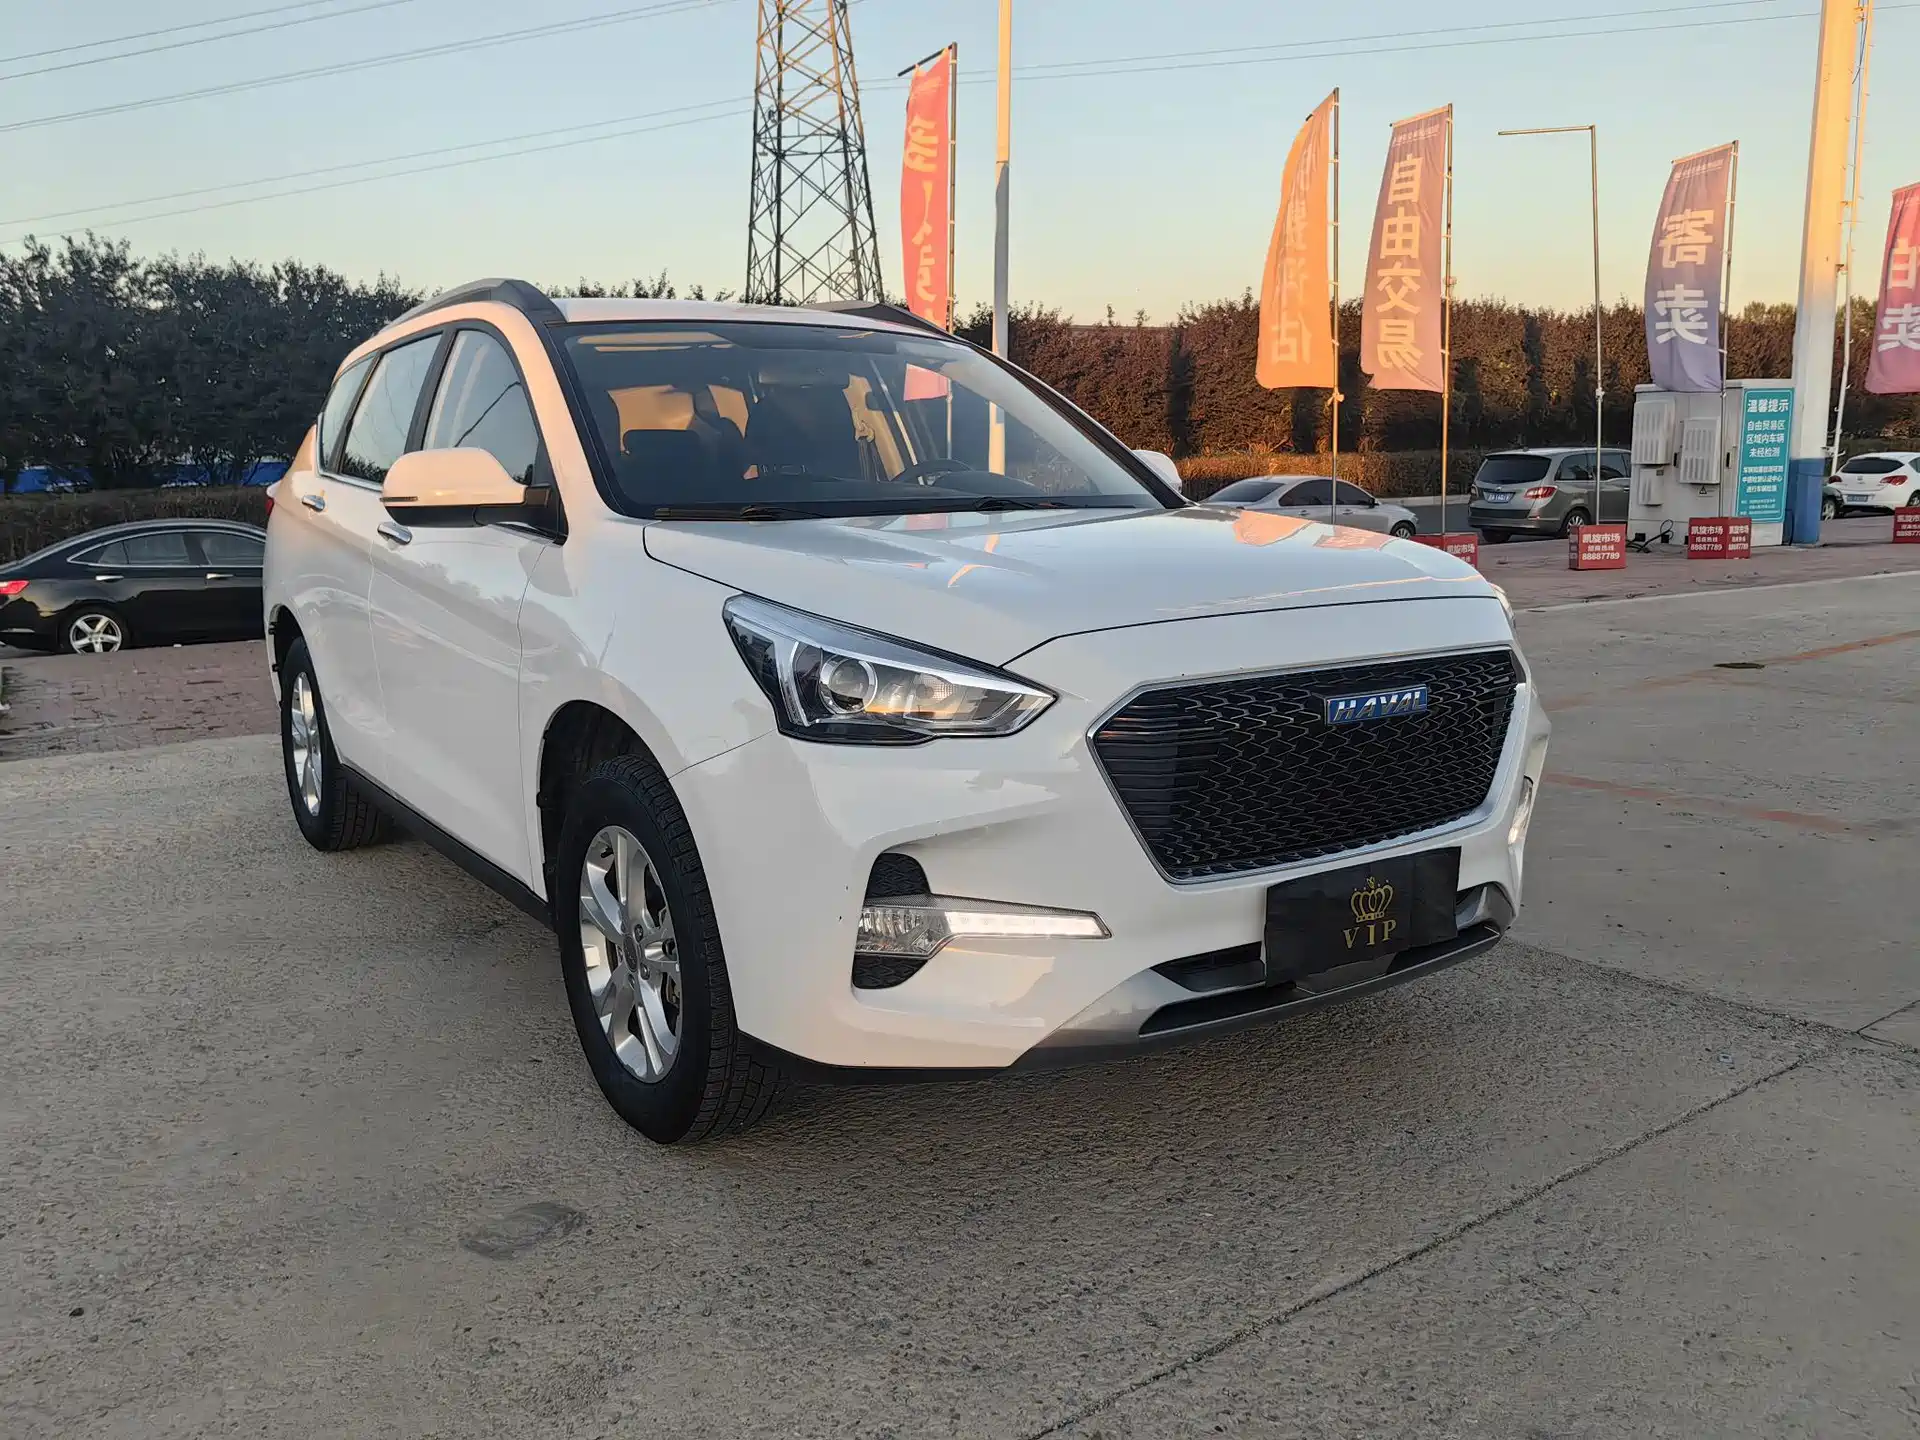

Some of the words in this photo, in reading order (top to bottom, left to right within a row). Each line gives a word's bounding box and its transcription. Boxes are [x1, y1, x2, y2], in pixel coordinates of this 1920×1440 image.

[1747, 398, 1789, 413] 温馨提示
[1334, 691, 1424, 721] HAVAL
[1343, 919, 1396, 950] VIP
